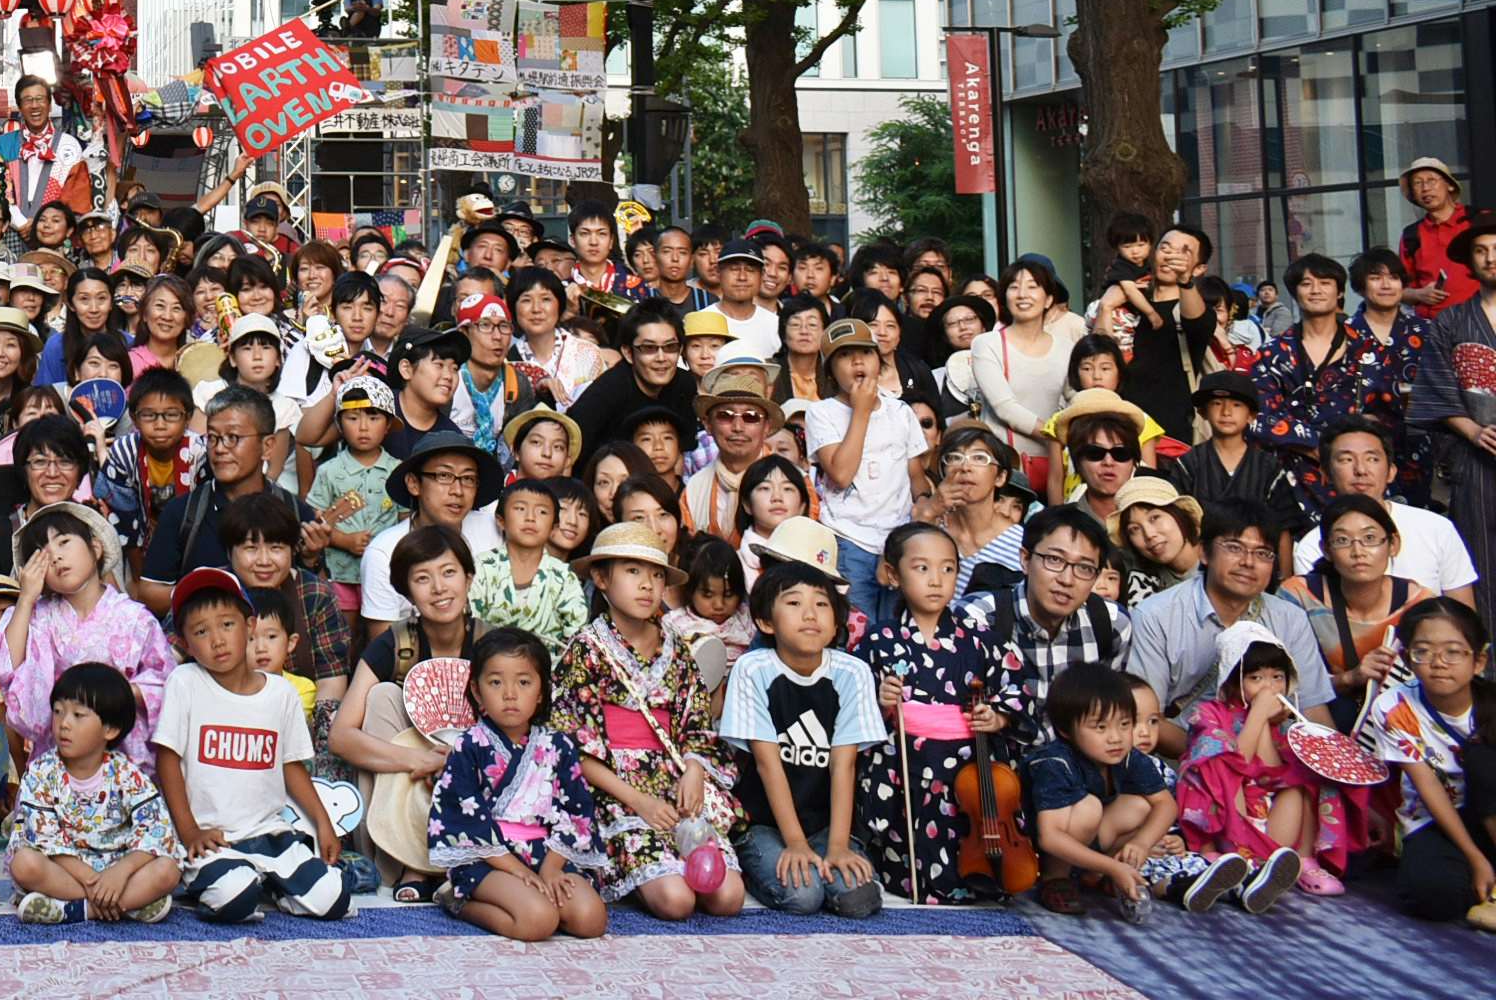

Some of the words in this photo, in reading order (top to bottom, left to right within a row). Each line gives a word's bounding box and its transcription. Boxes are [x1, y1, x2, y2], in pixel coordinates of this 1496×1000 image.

[245, 88, 333, 149] OVEN
[965, 62, 981, 165] Akarenga
[204, 729, 274, 764] CHUMS
[780, 745, 830, 768] dida
